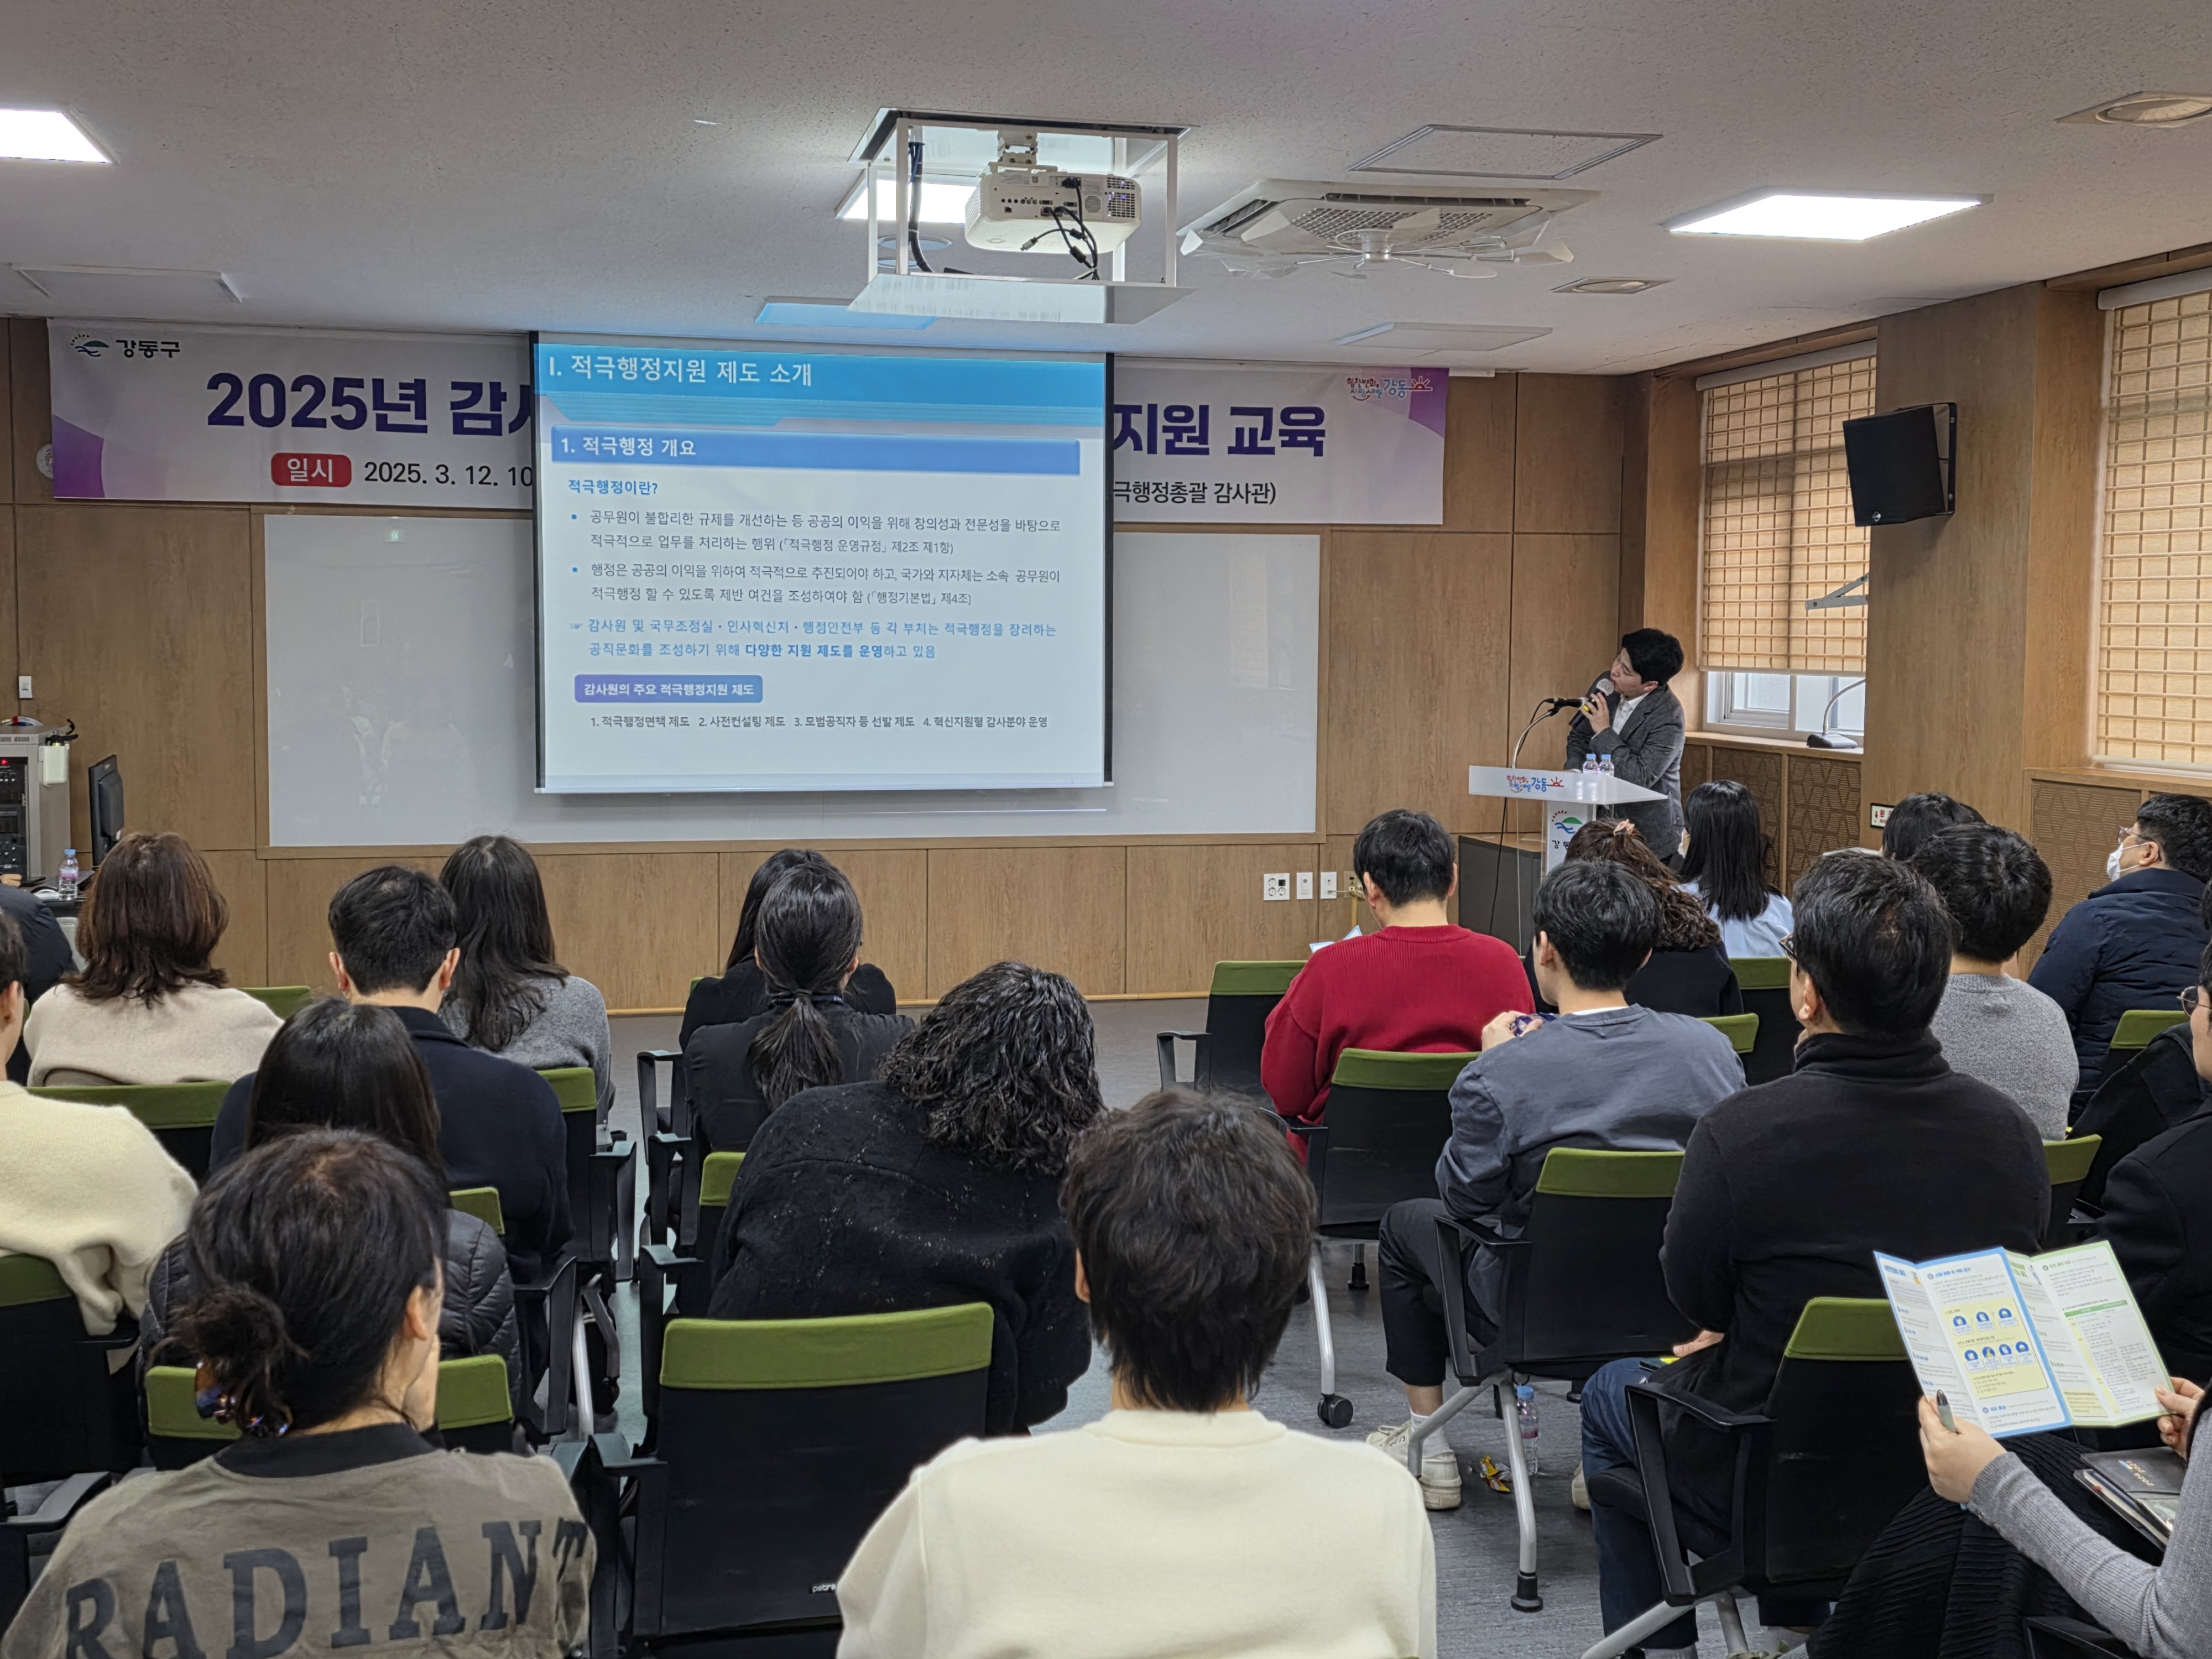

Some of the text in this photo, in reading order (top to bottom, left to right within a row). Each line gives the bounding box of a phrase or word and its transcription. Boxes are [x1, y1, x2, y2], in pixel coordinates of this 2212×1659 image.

[116, 340, 180, 358] 강동구
[571, 355, 706, 383] 적극행정지원
[717, 361, 760, 384] 제도
[770, 363, 811, 387] 소개
[1383, 378, 1406, 399] 강동
[206, 372, 428, 434] 2025년
[1227, 406, 1326, 457] 교육
[561, 437, 697, 457] 1. 적극행정 개요
[287, 458, 333, 483] 일시
[363, 461, 427, 484] 2025.
[435, 463, 456, 485] 3.
[465, 465, 498, 487] 12.
[568, 479, 658, 495] 적극행정이란?
[1213, 482, 1277, 505] 감사관)
[590, 510, 1061, 533] 공무원이 불합리한 규제를 개선하는 등 공공의 이익을 위해 창의성과 전문성을 바탕으로
[591, 534, 653, 548] 적극적으로
[659, 535, 695, 549] 업무를
[699, 536, 747, 550] 처리하는
[752, 538, 775, 551] 행위
[891, 540, 919, 553] 제2조
[922, 541, 953, 555] 제1항)
[591, 563, 628, 577] 행정은
[631, 564, 667, 577] 공공의
[671, 564, 707, 578] 이익을
[711, 565, 745, 578] 위하여
[750, 566, 808, 579] 적극적으로
[811, 566, 869, 581] 추진되어야
[900, 568, 935, 582] 국가와
[938, 568, 983, 582] 지자체는
[986, 570, 1009, 583] 소속
[1015, 570, 1060, 583] 공무원이
[591, 587, 640, 601] 적극행정
[645, 587, 658, 601] 할
[662, 588, 675, 601] 수
[679, 588, 715, 602] 있도록
[719, 588, 744, 602] 제반
[748, 589, 784, 603] 여건을
[788, 589, 848, 603] 조성하여야
[852, 590, 863, 604] 함
[941, 592, 971, 606] 제4조)
[588, 619, 625, 633] 감사원
[633, 619, 644, 633] 및
[650, 619, 712, 633] 국무조정실
[727, 620, 789, 634] 인사혁신처
[803, 621, 863, 634] 행정안전부
[870, 622, 881, 635] 등
[886, 622, 897, 635] 각
[903, 622, 939, 635] 부처는
[945, 623, 1003, 637] 적극행정을
[1009, 623, 1056, 637] 장려하는
[589, 643, 935, 659] 공직문화를 조성하기 위해 다양한 지원 제도를 운영하고 있음
[584, 683, 754, 696] 감사원의 주요 적극행정지원 제도
[591, 716, 1047, 728] 1. 적극행정면책 제도 2. 사전컨설팅 제도 3. 모범공직자 등 선발 제도 4. 혁신지원형 감사분야 운영
[1531, 777, 1547, 792] 강동
